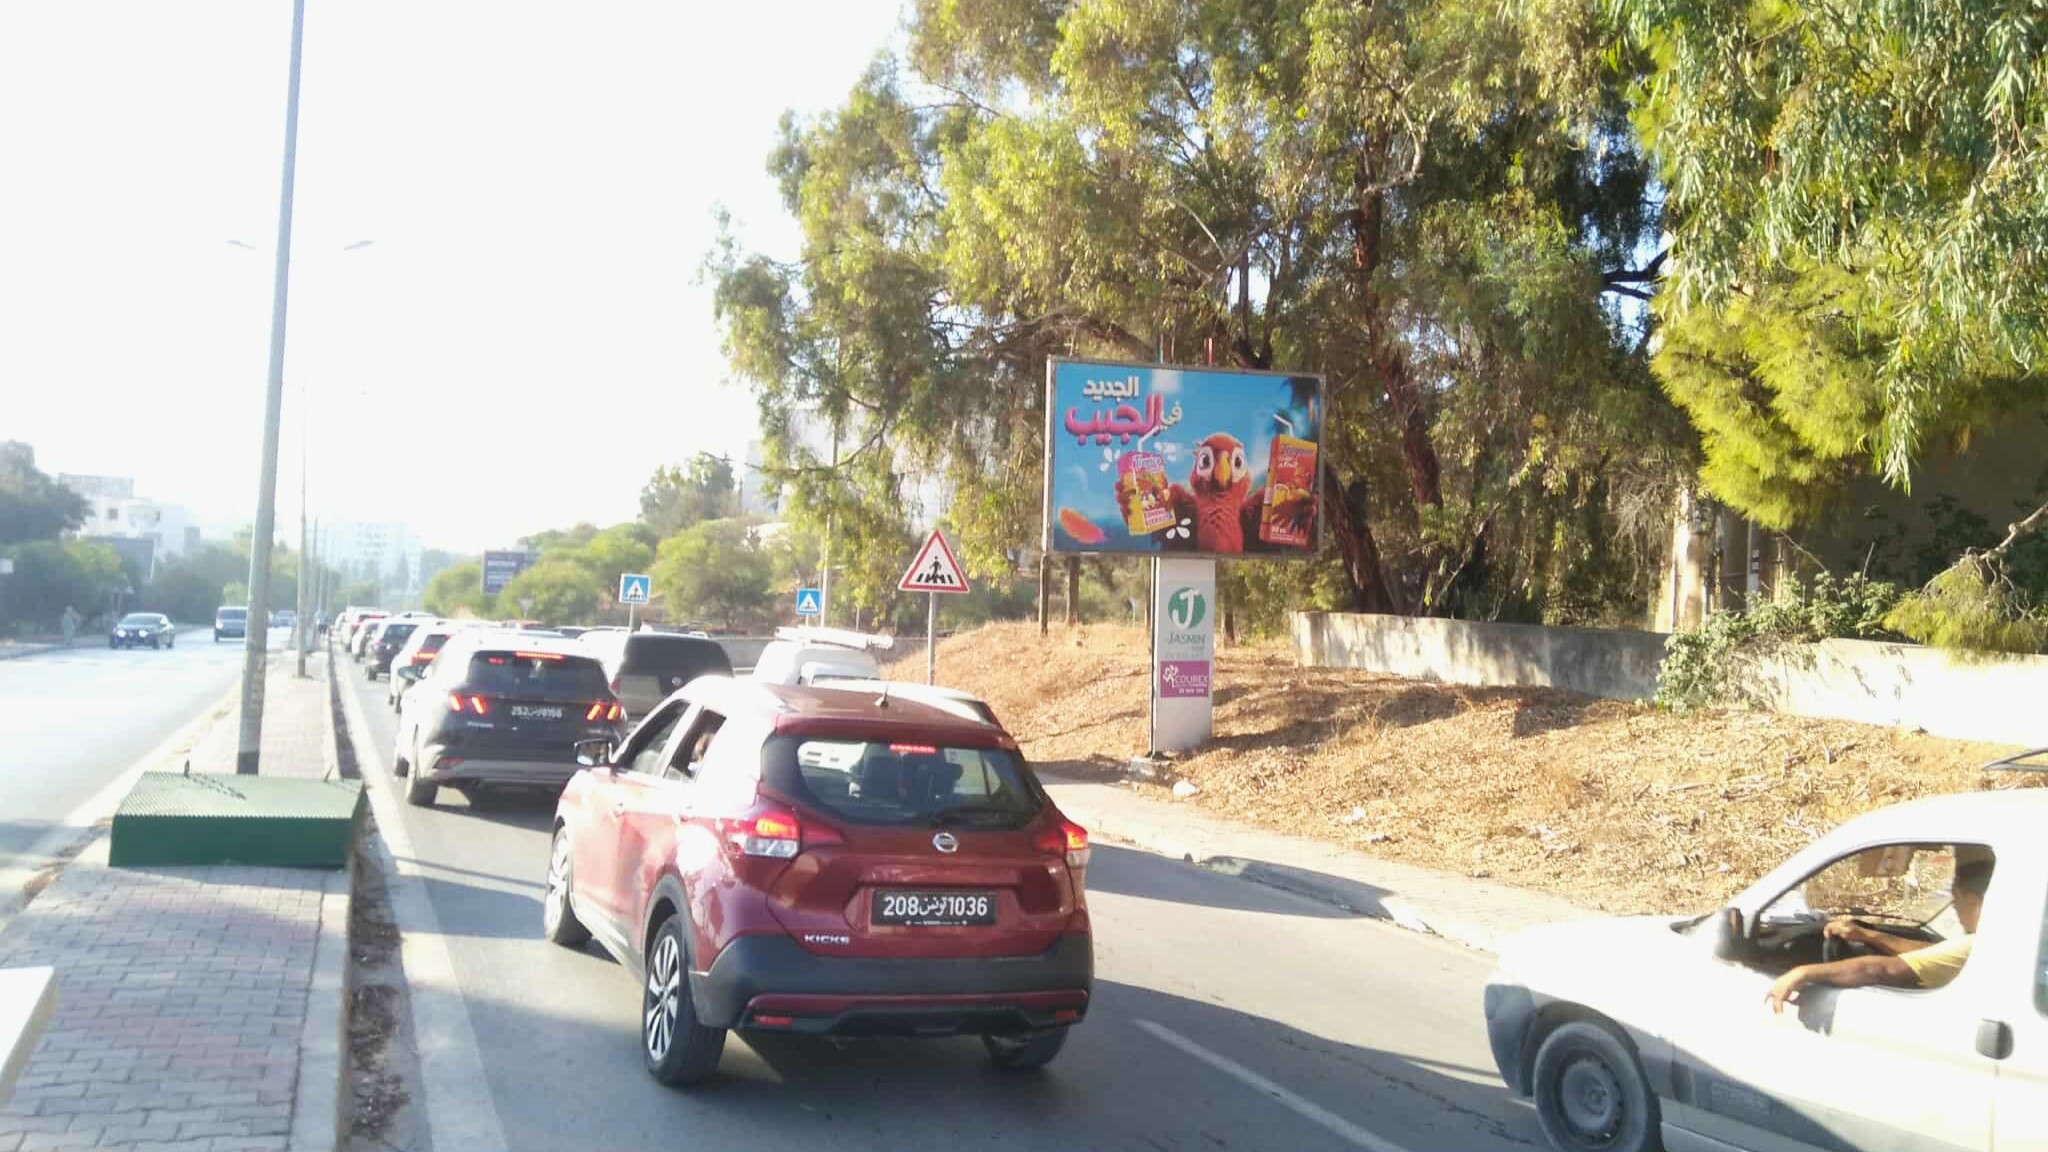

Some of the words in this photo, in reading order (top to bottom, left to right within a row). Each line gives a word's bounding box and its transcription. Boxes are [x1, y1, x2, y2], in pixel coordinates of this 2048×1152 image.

[1083, 376, 1139, 403] الجديد
[1064, 393, 1164, 446] الجيب
[1168, 632, 1206, 645] JASMIN
[883, 895, 918, 916] 208
[948, 896, 988, 917] 1036
[804, 934, 849, 945] KICKS
